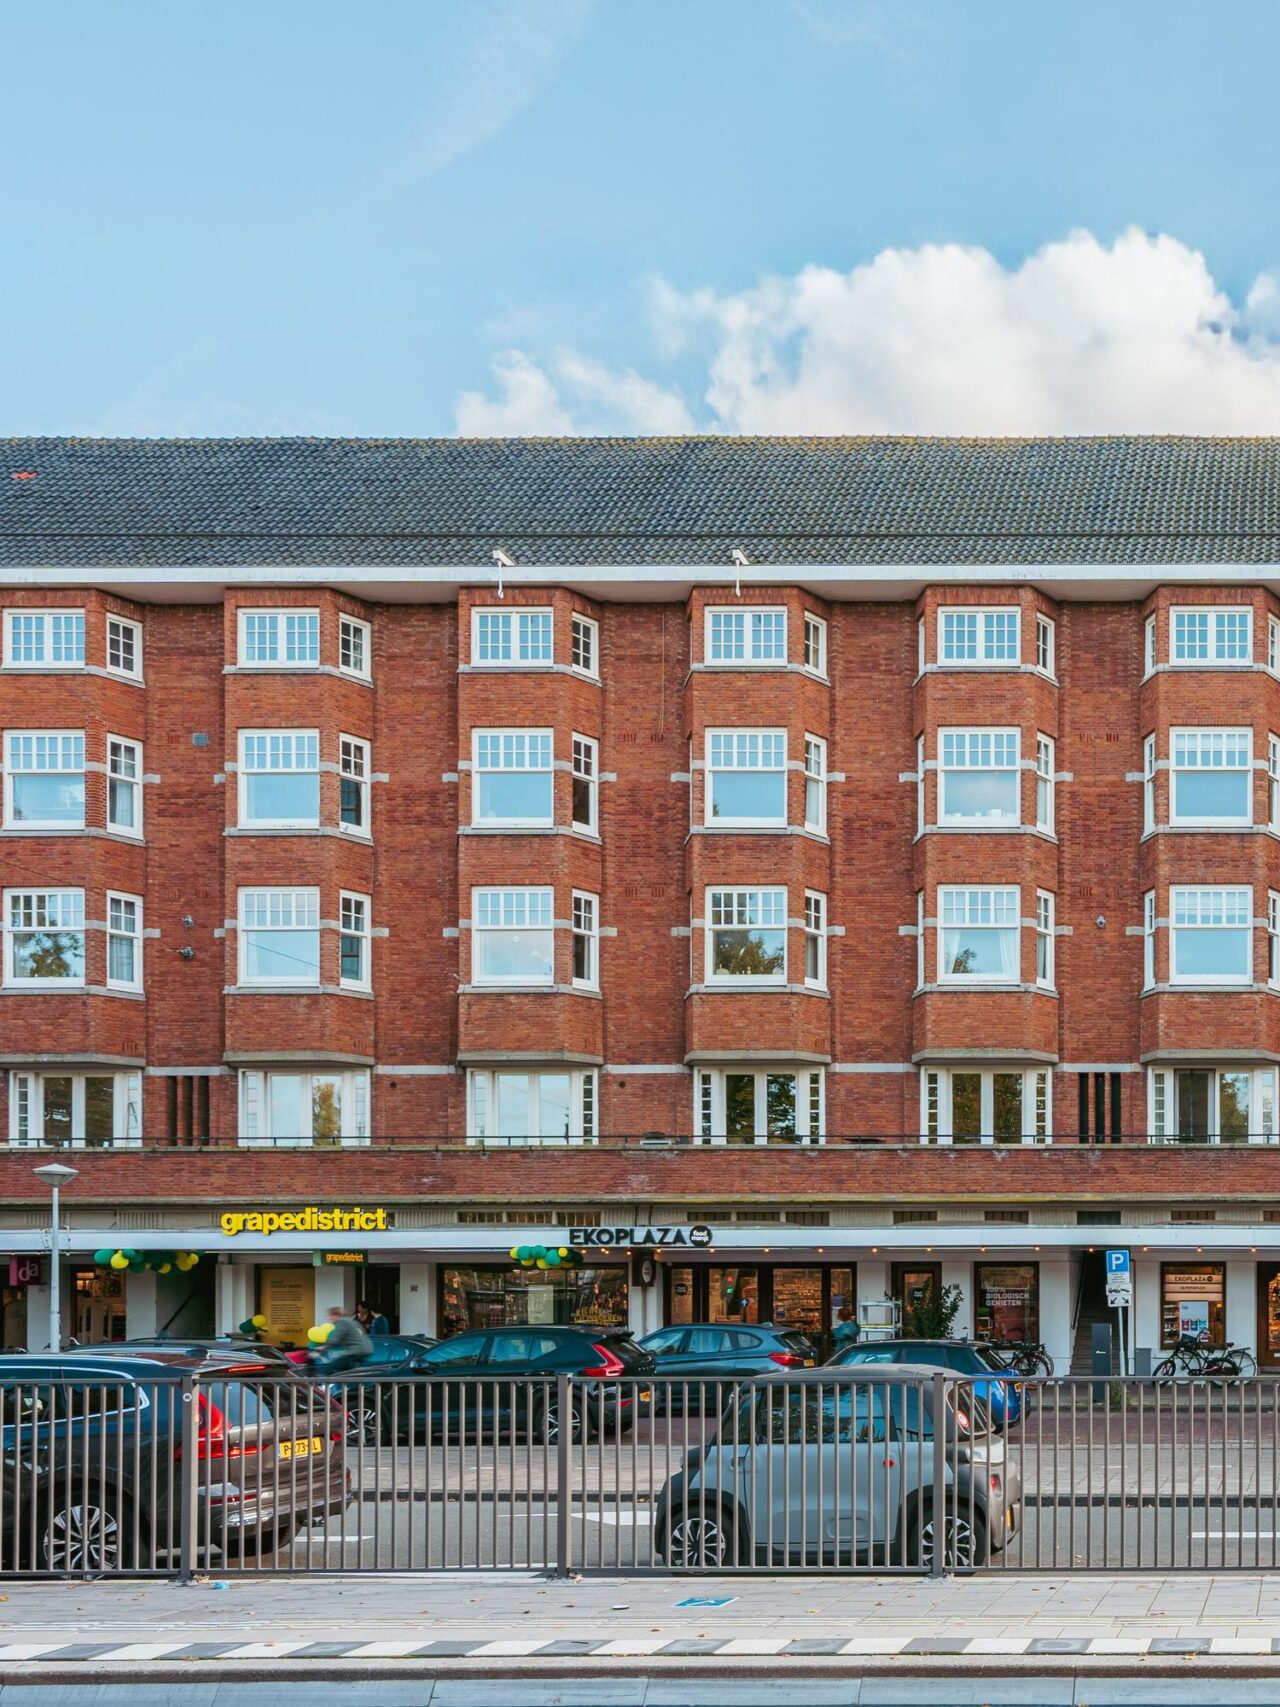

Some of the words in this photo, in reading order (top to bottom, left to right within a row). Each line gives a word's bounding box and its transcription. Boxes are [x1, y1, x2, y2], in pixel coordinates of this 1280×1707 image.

[220, 1207, 387, 1236] grapedistrict
[569, 1228, 688, 1245] EKOPLAZA
[325, 1252, 364, 1263] grapedistrict
[1111, 1253, 1124, 1271] P
[18, 1260, 39, 1281] da
